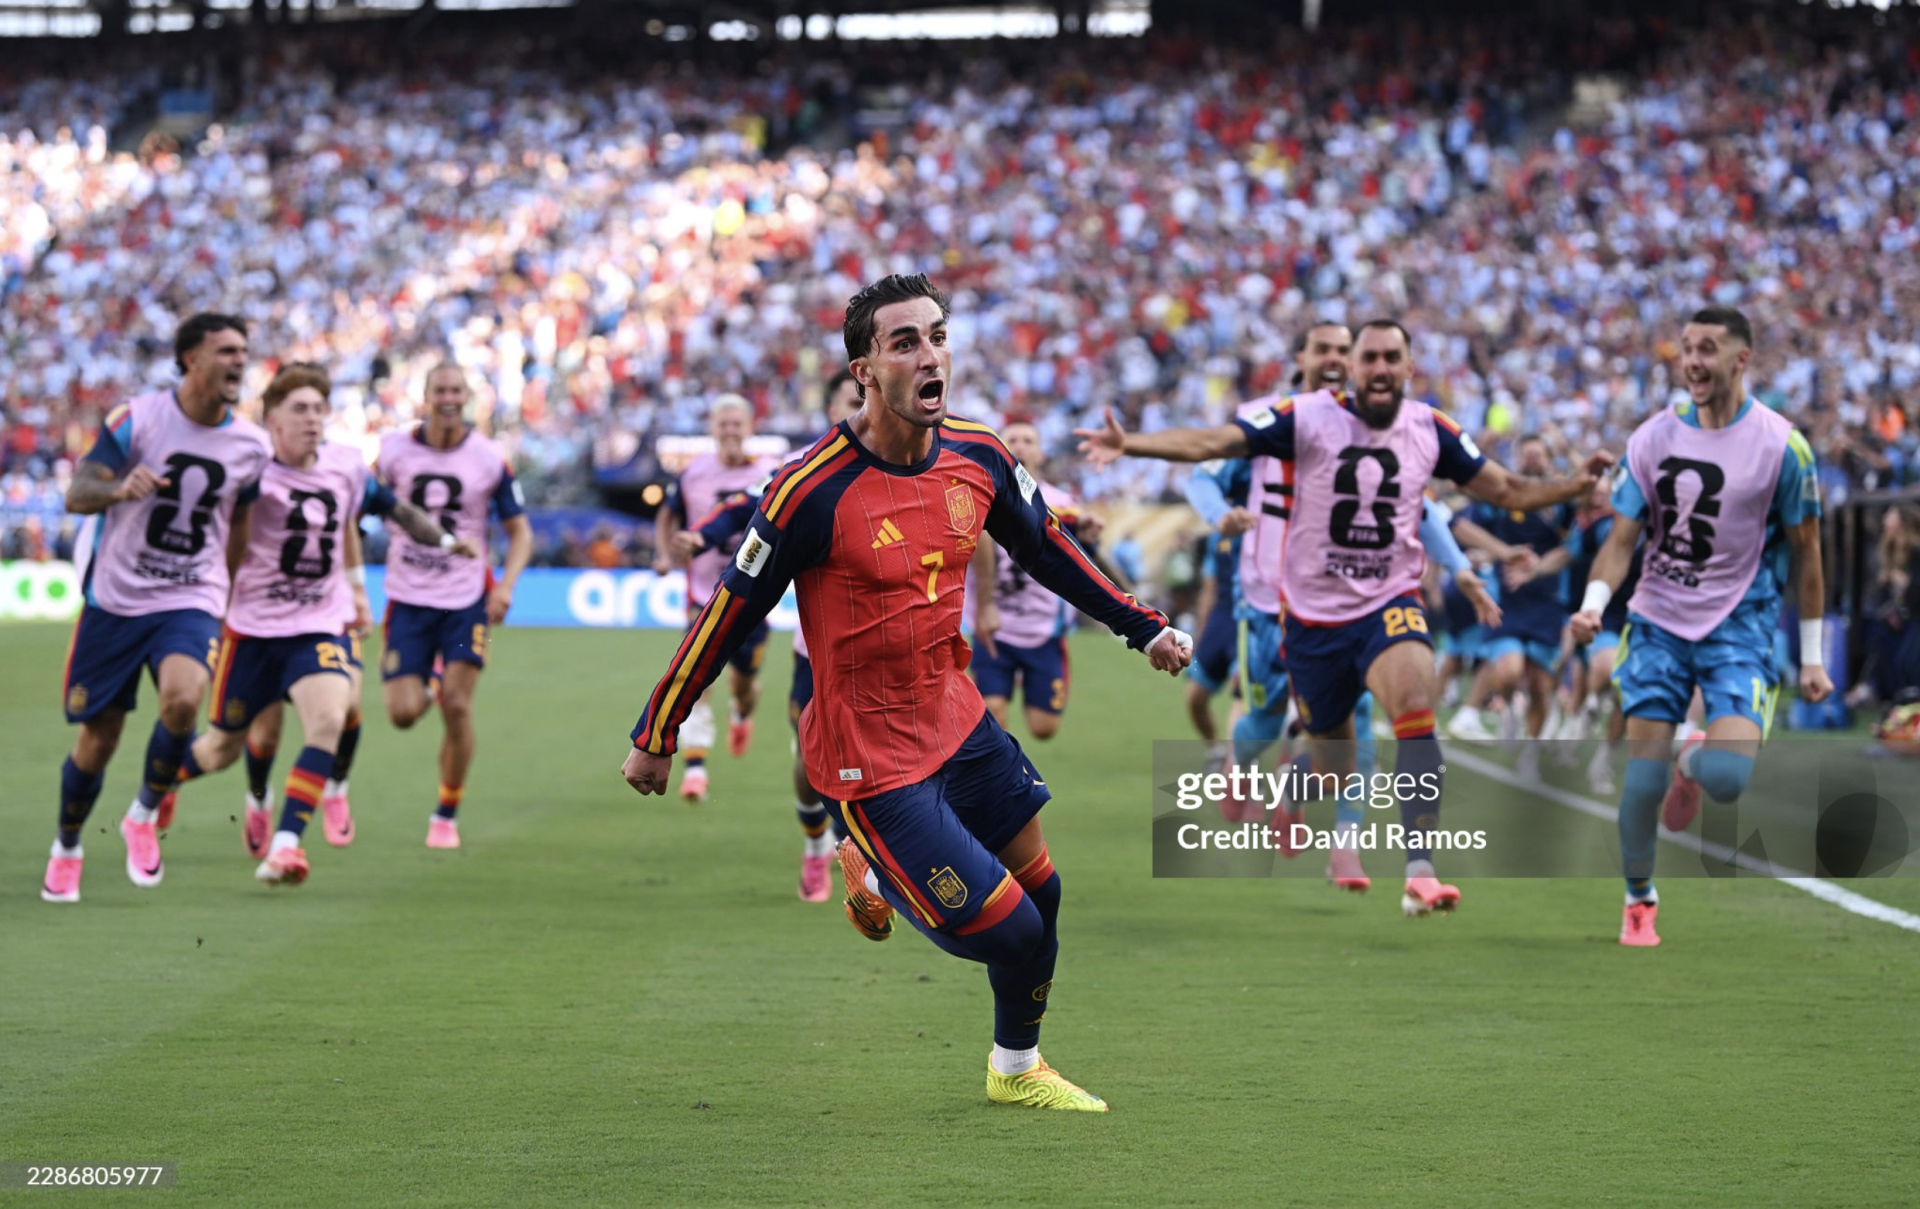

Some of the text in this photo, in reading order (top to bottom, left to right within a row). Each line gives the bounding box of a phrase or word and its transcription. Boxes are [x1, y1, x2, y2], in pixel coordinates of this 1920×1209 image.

[1346, 528, 1380, 543] FIFA
[921, 551, 944, 604] 7
[1325, 562, 1390, 581] 2026
[1383, 606, 1428, 637] 26
